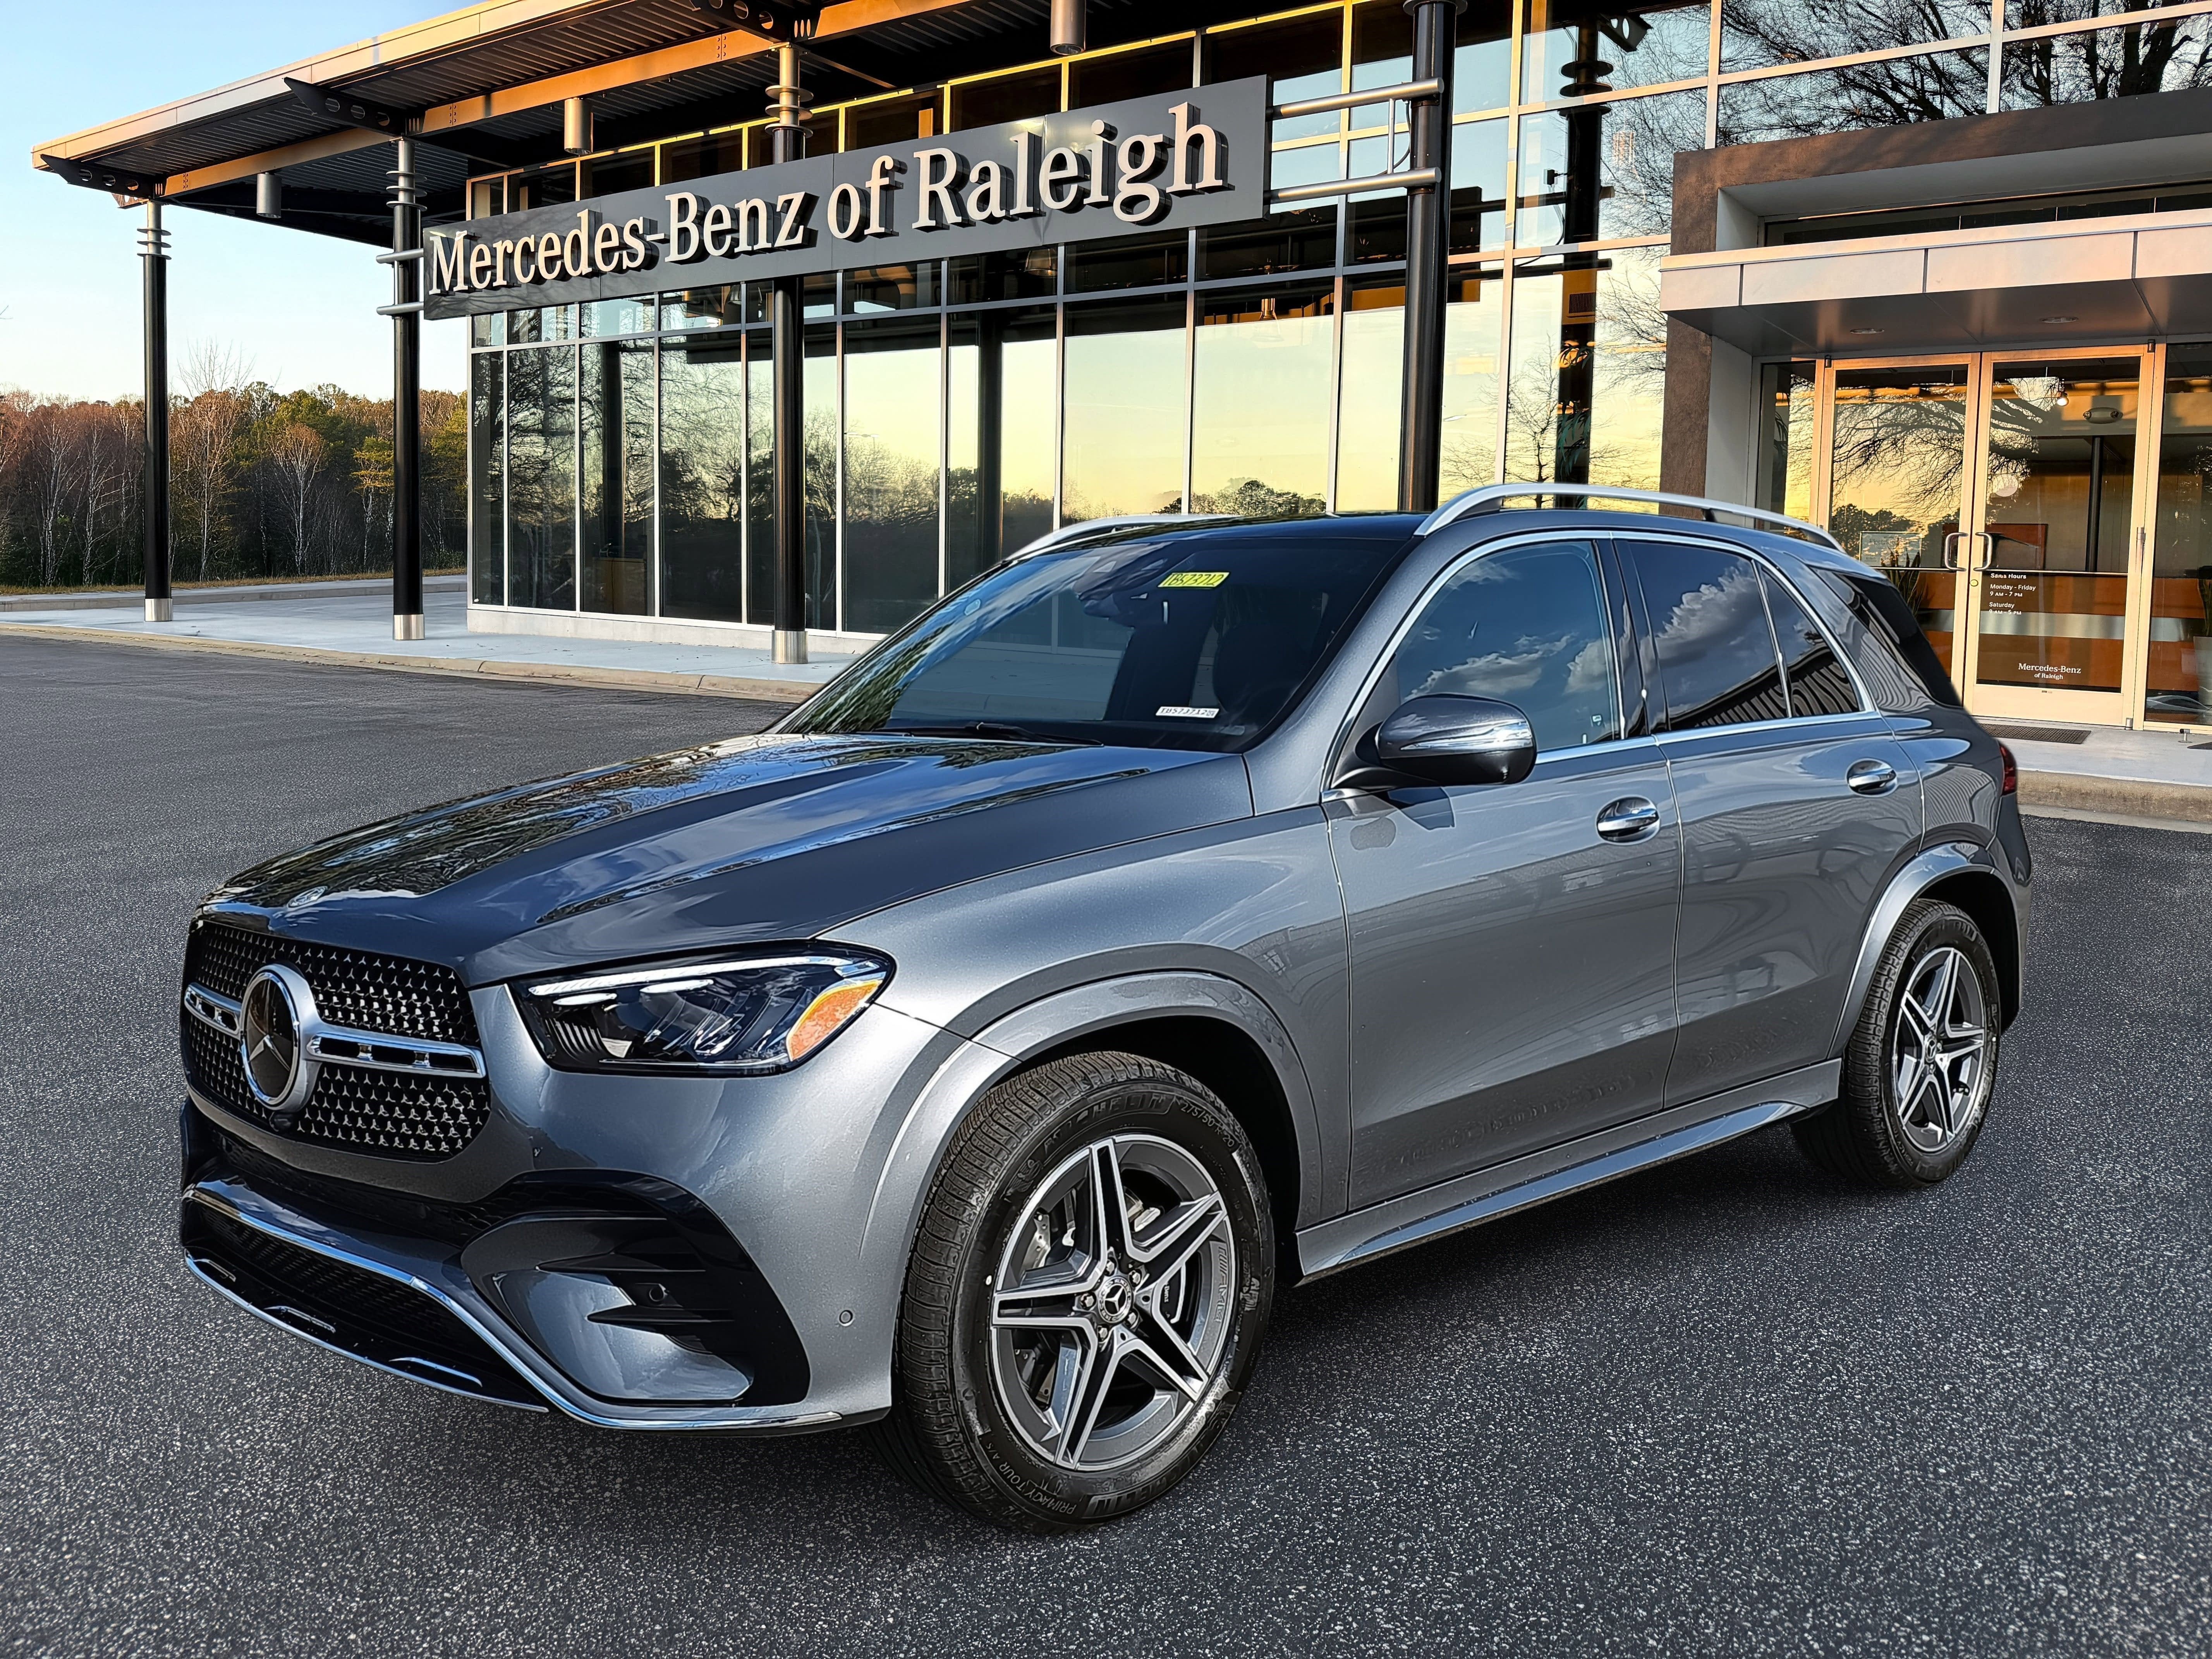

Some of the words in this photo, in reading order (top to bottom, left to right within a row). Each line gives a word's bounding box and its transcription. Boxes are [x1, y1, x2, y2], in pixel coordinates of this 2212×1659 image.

[428, 191, 805, 295] Mercedes-Benz
[827, 155, 894, 239] of
[912, 101, 1223, 222] Raleigh
[2018, 663, 2081, 674] Mercedes-Benz
[1181, 1103, 1215, 1127] 275/50
[1222, 1133, 1235, 1147] 20
[987, 1443, 1000, 1460] A/S
[999, 1462, 1026, 1491] TOUR
[1024, 1489, 1077, 1515] PRIMACY
